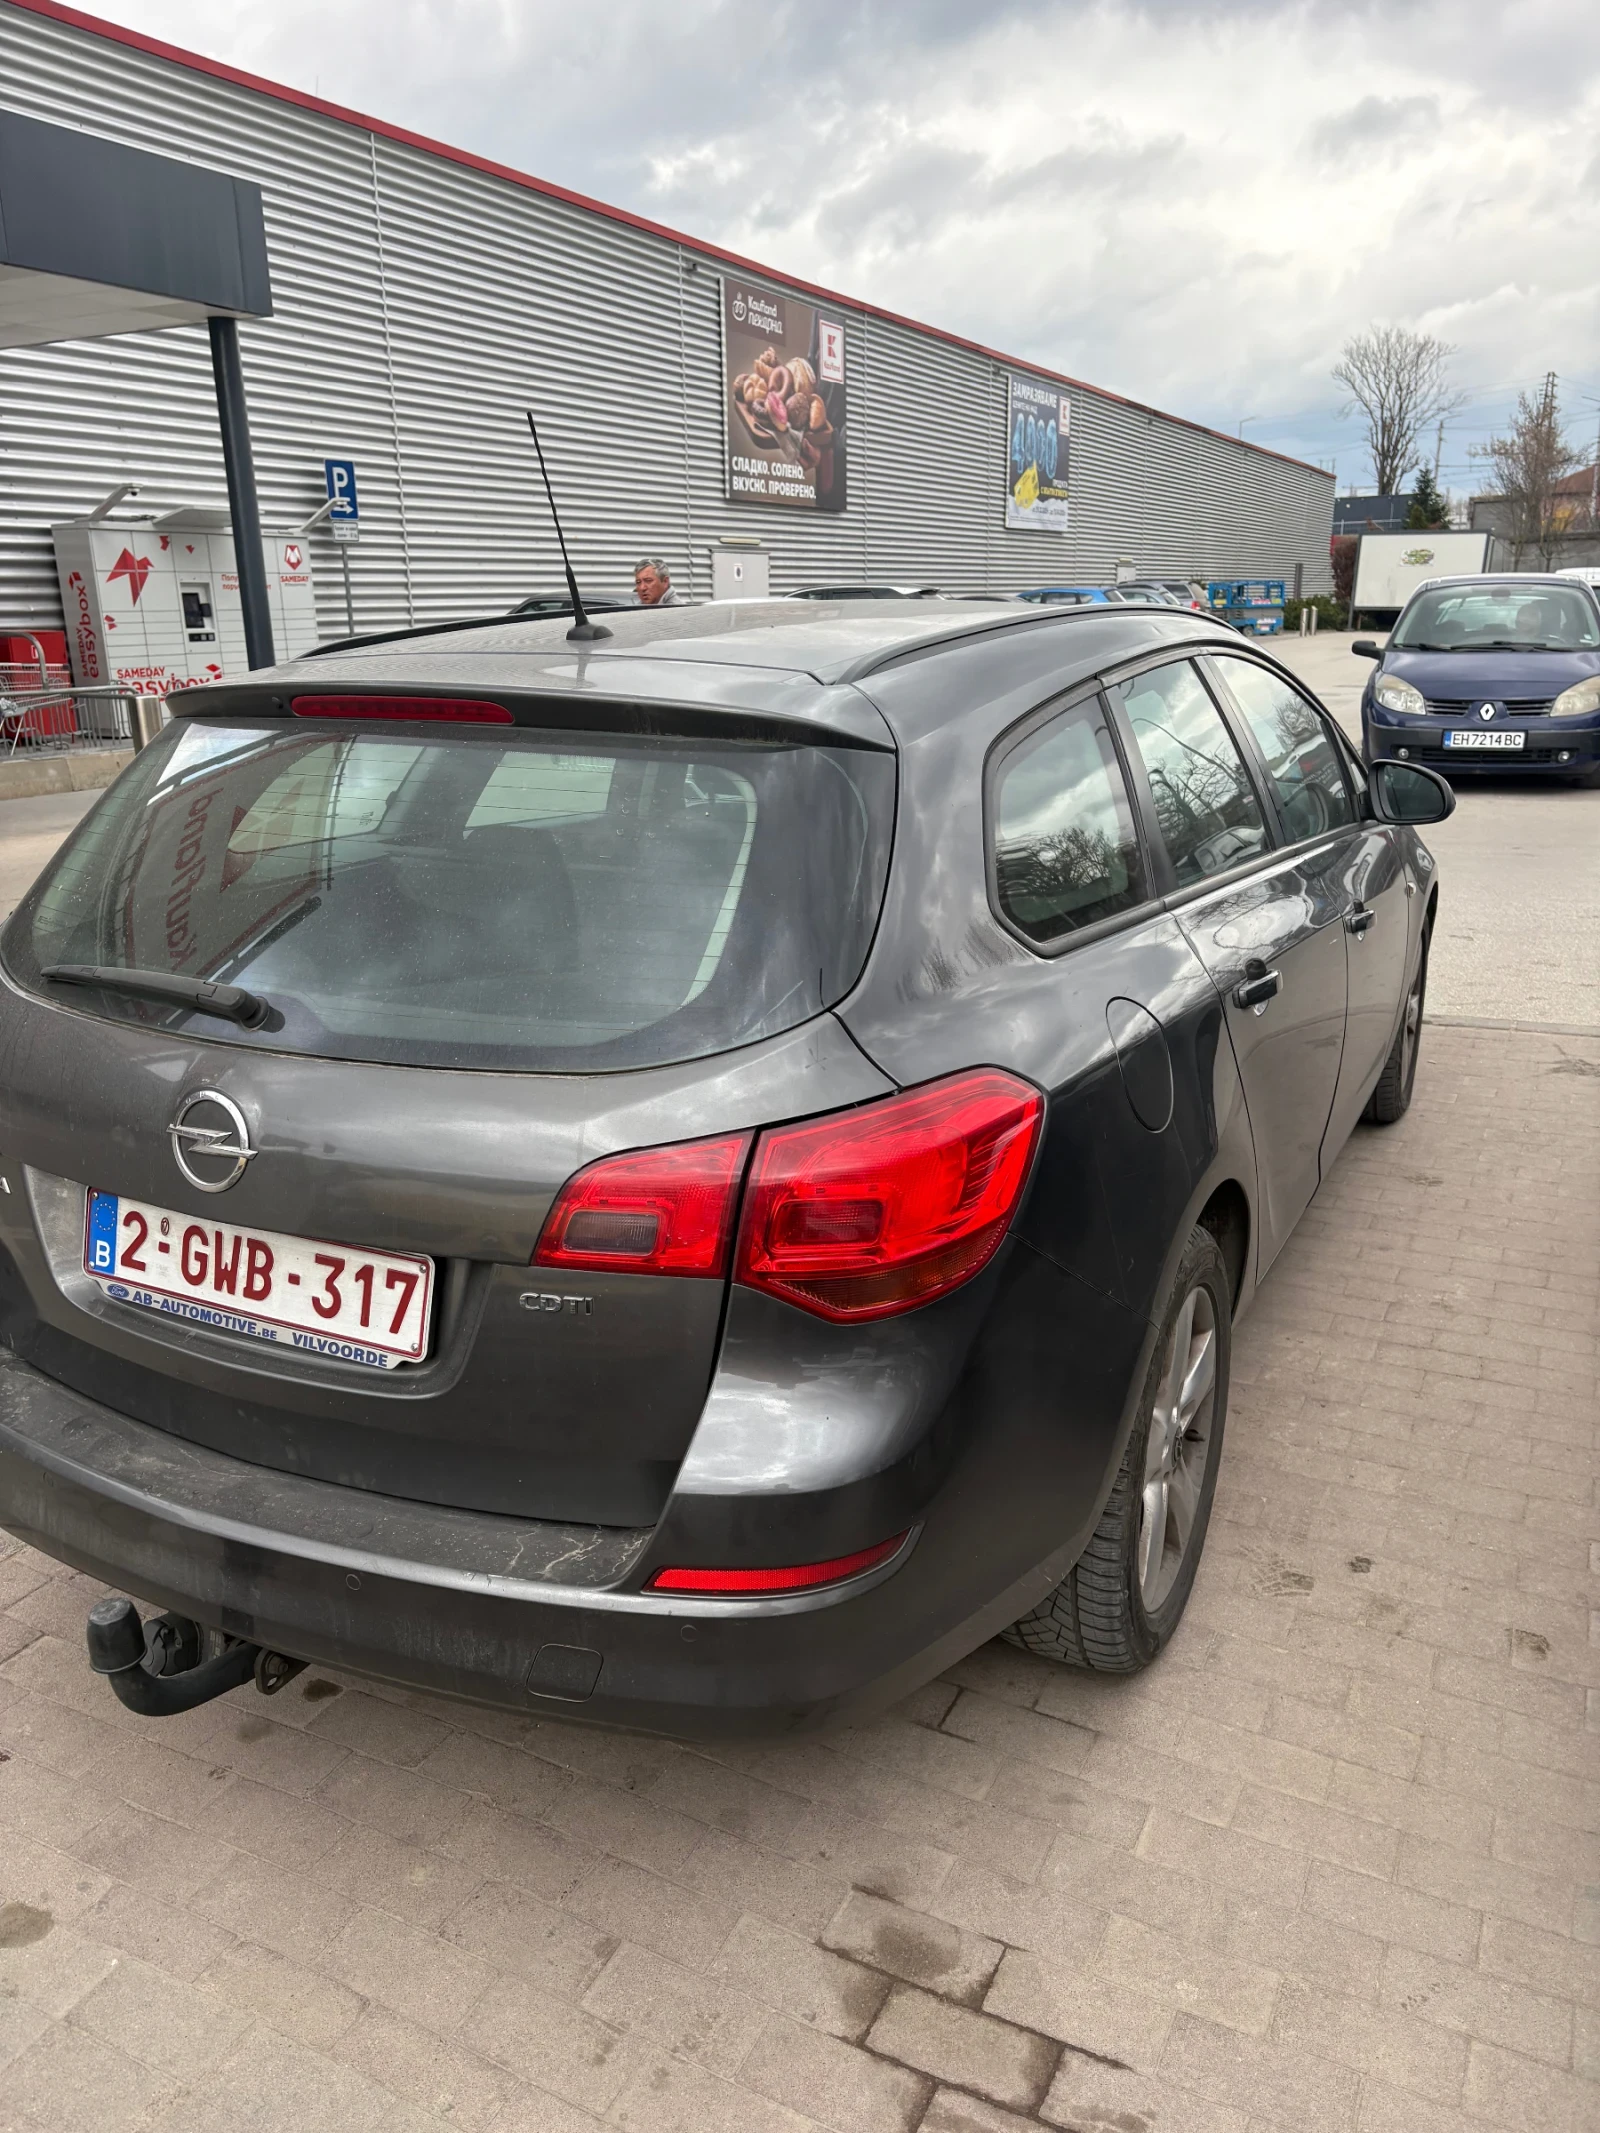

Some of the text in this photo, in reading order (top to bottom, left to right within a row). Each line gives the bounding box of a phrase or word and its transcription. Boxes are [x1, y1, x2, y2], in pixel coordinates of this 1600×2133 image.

[748, 295, 778, 317] Kaufland
[731, 455, 806, 480] СЛАДКО. СОЛЕНО.
[332, 466, 349, 498] P
[732, 475, 817, 500] ВКУСНО. ПРОВЕРЕНО.
[280, 575, 309, 583] SAMEDAY
[76, 585, 99, 678] easybox
[76, 627, 89, 677] SAMEDAY
[117, 666, 166, 679] SAMEDAY
[95, 1210, 419, 1335] B 2-GWB-317
[519, 1291, 594, 1316] CDTI
[110, 1285, 388, 1368] Ford AB-AUTOMOTIVE.BE VILVOORDE
